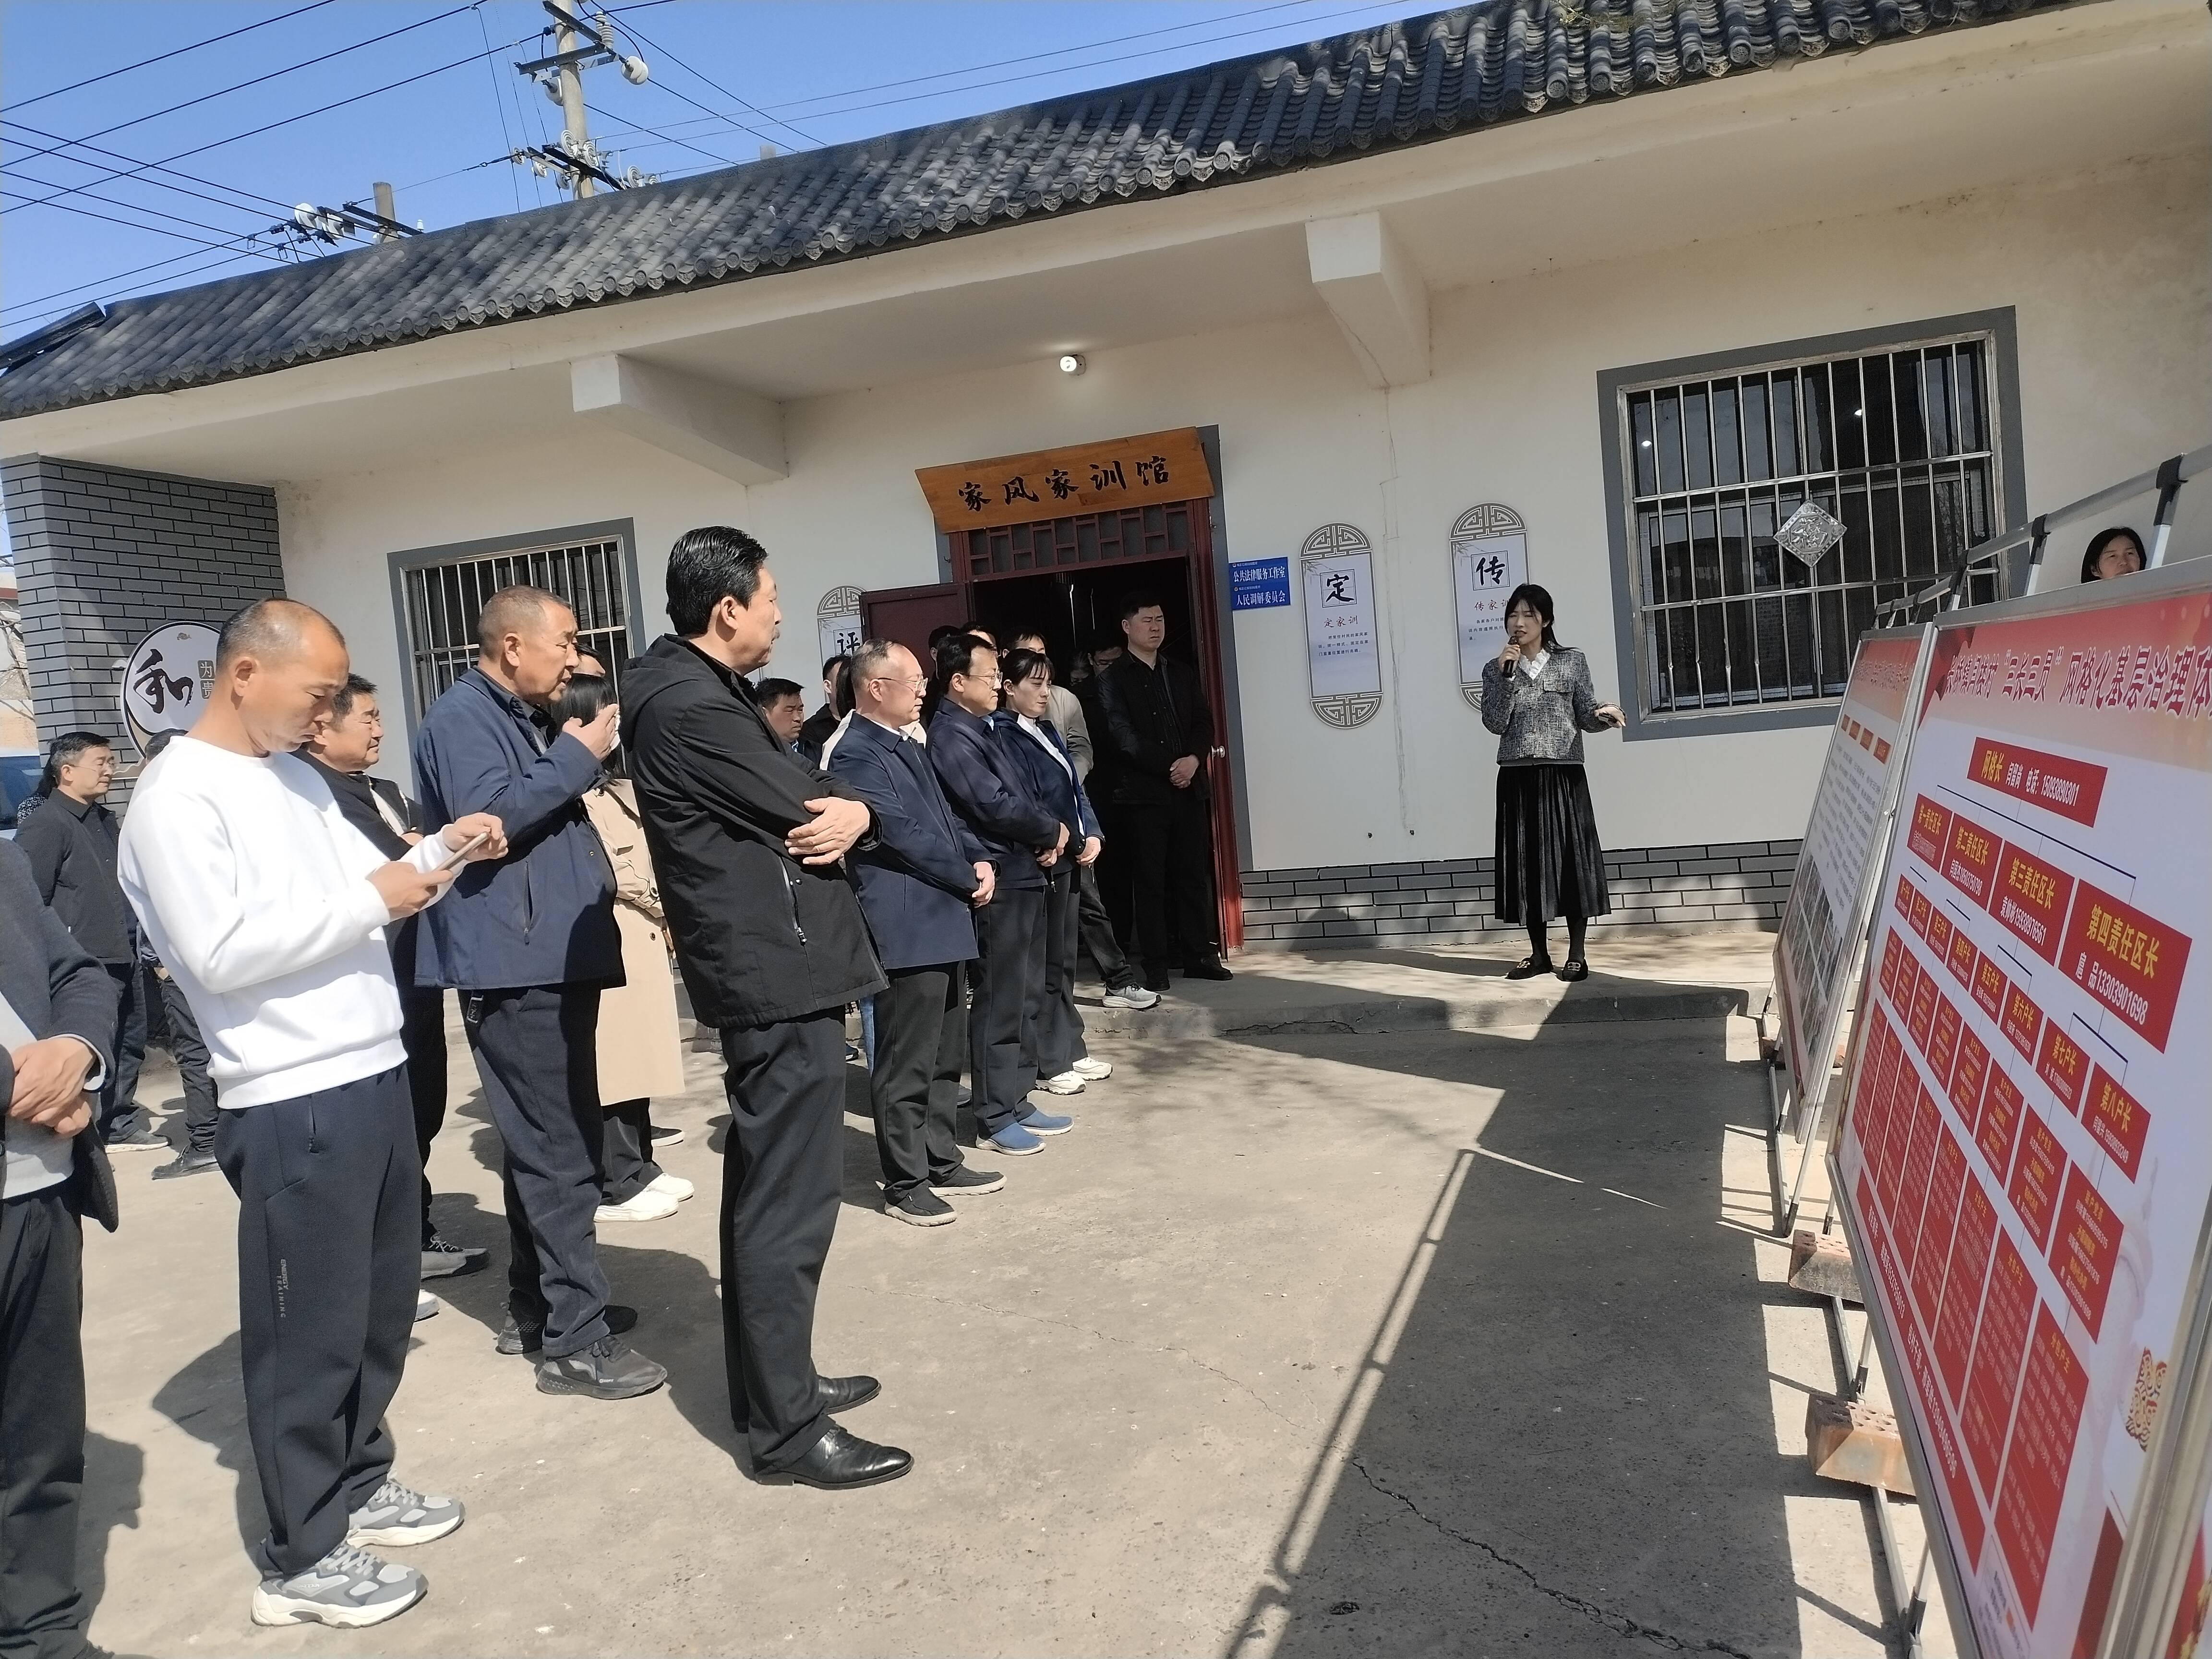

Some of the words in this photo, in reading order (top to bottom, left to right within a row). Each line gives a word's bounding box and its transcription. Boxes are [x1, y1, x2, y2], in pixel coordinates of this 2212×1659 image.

[959, 455, 1169, 512] 家风家训馆
[1233, 566, 1286, 582] 公共法律服务工作室
[1476, 556, 1505, 586] 传
[1237, 590, 1286, 606] 人民调解委员会
[1326, 574, 1354, 602] 定
[1324, 615, 1358, 628] 定家训
[133, 649, 194, 714] 和
[1981, 750, 2004, 782] 网格长
[1918, 804, 1942, 835] 第一责任区长
[1956, 826, 1989, 866] 第二责任区长
[2008, 857, 2055, 909] 第三责任区长
[1934, 914, 1947, 939] 第三户长
[2087, 904, 2159, 978] 第四责任区长
[1956, 936, 1971, 964] 第四户长
[1982, 962, 1999, 994] 第五户长
[2013, 993, 2034, 1030] 第六户长
[2053, 1034, 2076, 1075] 第七户长
[2100, 1082, 2131, 1133] 第八户长
[276, 1275, 286, 1317] TRAINING
